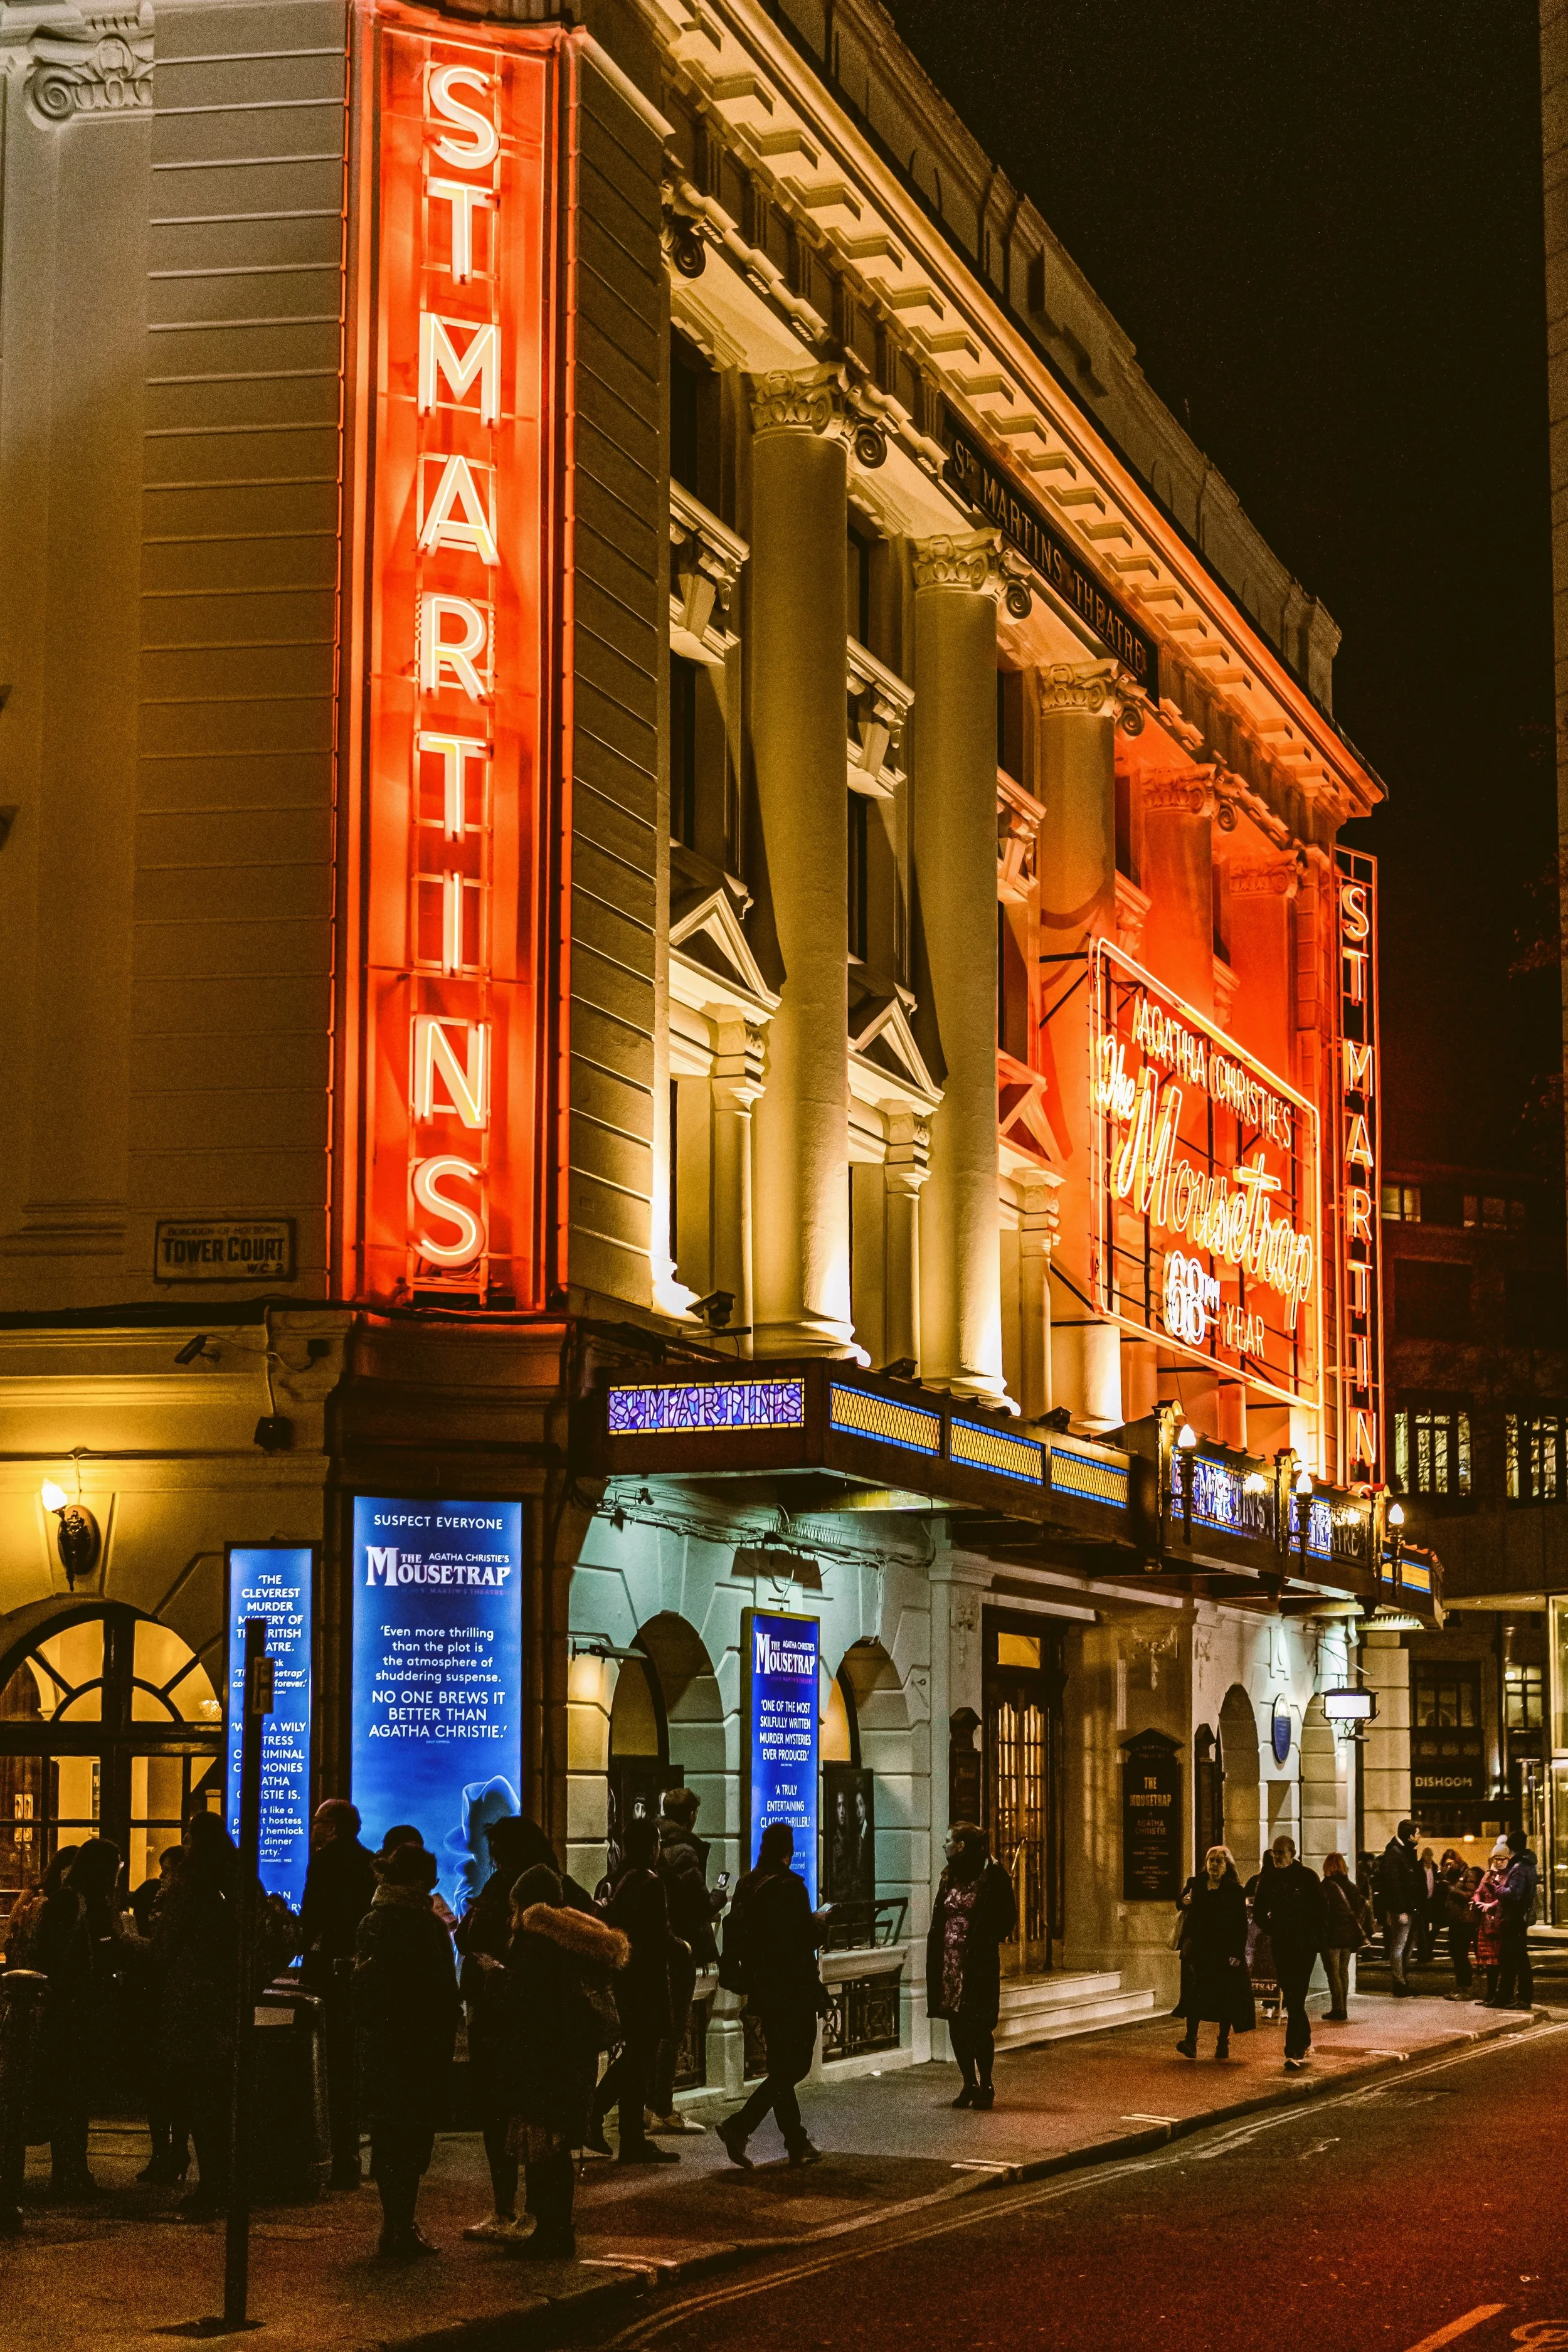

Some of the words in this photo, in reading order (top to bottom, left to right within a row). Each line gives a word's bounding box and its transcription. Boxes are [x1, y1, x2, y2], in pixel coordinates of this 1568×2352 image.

[426, 63, 500, 286] ST
[1073, 569, 1147, 672] THEATRE
[410, 310, 502, 1268] MARTINS
[1095, 1035, 1135, 1120] The
[1132, 995, 1207, 1089] AGATHA
[1210, 1054, 1292, 1150] CHRISTIE'S
[1111, 1066, 1313, 1329] Mousetrap
[162, 1238, 223, 1263] TOWER
[228, 1237, 285, 1261] COURT
[1343, 1039, 1377, 1498] MARTIN
[1225, 1301, 1264, 1359] YEAR
[374, 1515, 431, 1527] SUSPECT
[437, 1517, 503, 1530] EVERYONE
[401, 1554, 422, 1564] THE
[429, 1553, 464, 1562] AGATHA
[465, 1554, 509, 1563] CHRISTIE'S
[366, 1545, 511, 1587] MOUSETRAP
[241, 1588, 300, 1598] CLEVEREST
[247, 1602, 294, 1611] MURDER
[288, 1615, 304, 1625] OF
[415, 1628, 445, 1637] more
[449, 1628, 494, 1641] thrilling
[392, 1641, 420, 1651] than
[424, 1643, 443, 1652] the
[448, 1642, 470, 1655] plot
[475, 1643, 484, 1653] is
[771, 1641, 780, 1651] THE
[783, 1640, 797, 1650] AGATHA
[797, 1641, 815, 1652] CHRISTIE'S
[755, 1632, 815, 1675] MOUSETRAP
[383, 1656, 403, 1666] the
[407, 1657, 477, 1670] atmosphere
[481, 1657, 493, 1668] of
[376, 1671, 442, 1683] shuddering
[446, 1673, 502, 1684] suspense.
[372, 1691, 396, 1703] NO
[401, 1691, 433, 1703] ONE
[439, 1692, 489, 1704] BREWS
[493, 1692, 506, 1705] IT
[776, 1700, 784, 1712] OF
[785, 1701, 795, 1713] THE
[797, 1702, 810, 1714] MOST
[388, 1708, 441, 1720] BETTER
[446, 1708, 487, 1721] THAN
[269, 1723, 277, 1732] A
[280, 1722, 307, 1732] WILY
[760, 1715, 788, 1729] SKILFULLY
[789, 1717, 811, 1730] WRITTEN
[369, 1724, 430, 1737] AGATHA
[760, 1732, 783, 1744] MURDER
[785, 1734, 811, 1745] MYSTERIES
[763, 1749, 776, 1760] EVER
[1144, 1777, 1157, 1789] THE
[1415, 1776, 1473, 1787] DISHOOM
[288, 1790, 301, 1799] IS.
[781, 1784, 797, 1796] TRULY
[766, 1801, 805, 1812] ENTERTAINING
[1130, 1794, 1172, 1806] MOUSETRAP
[266, 1826, 304, 1835] hemlock
